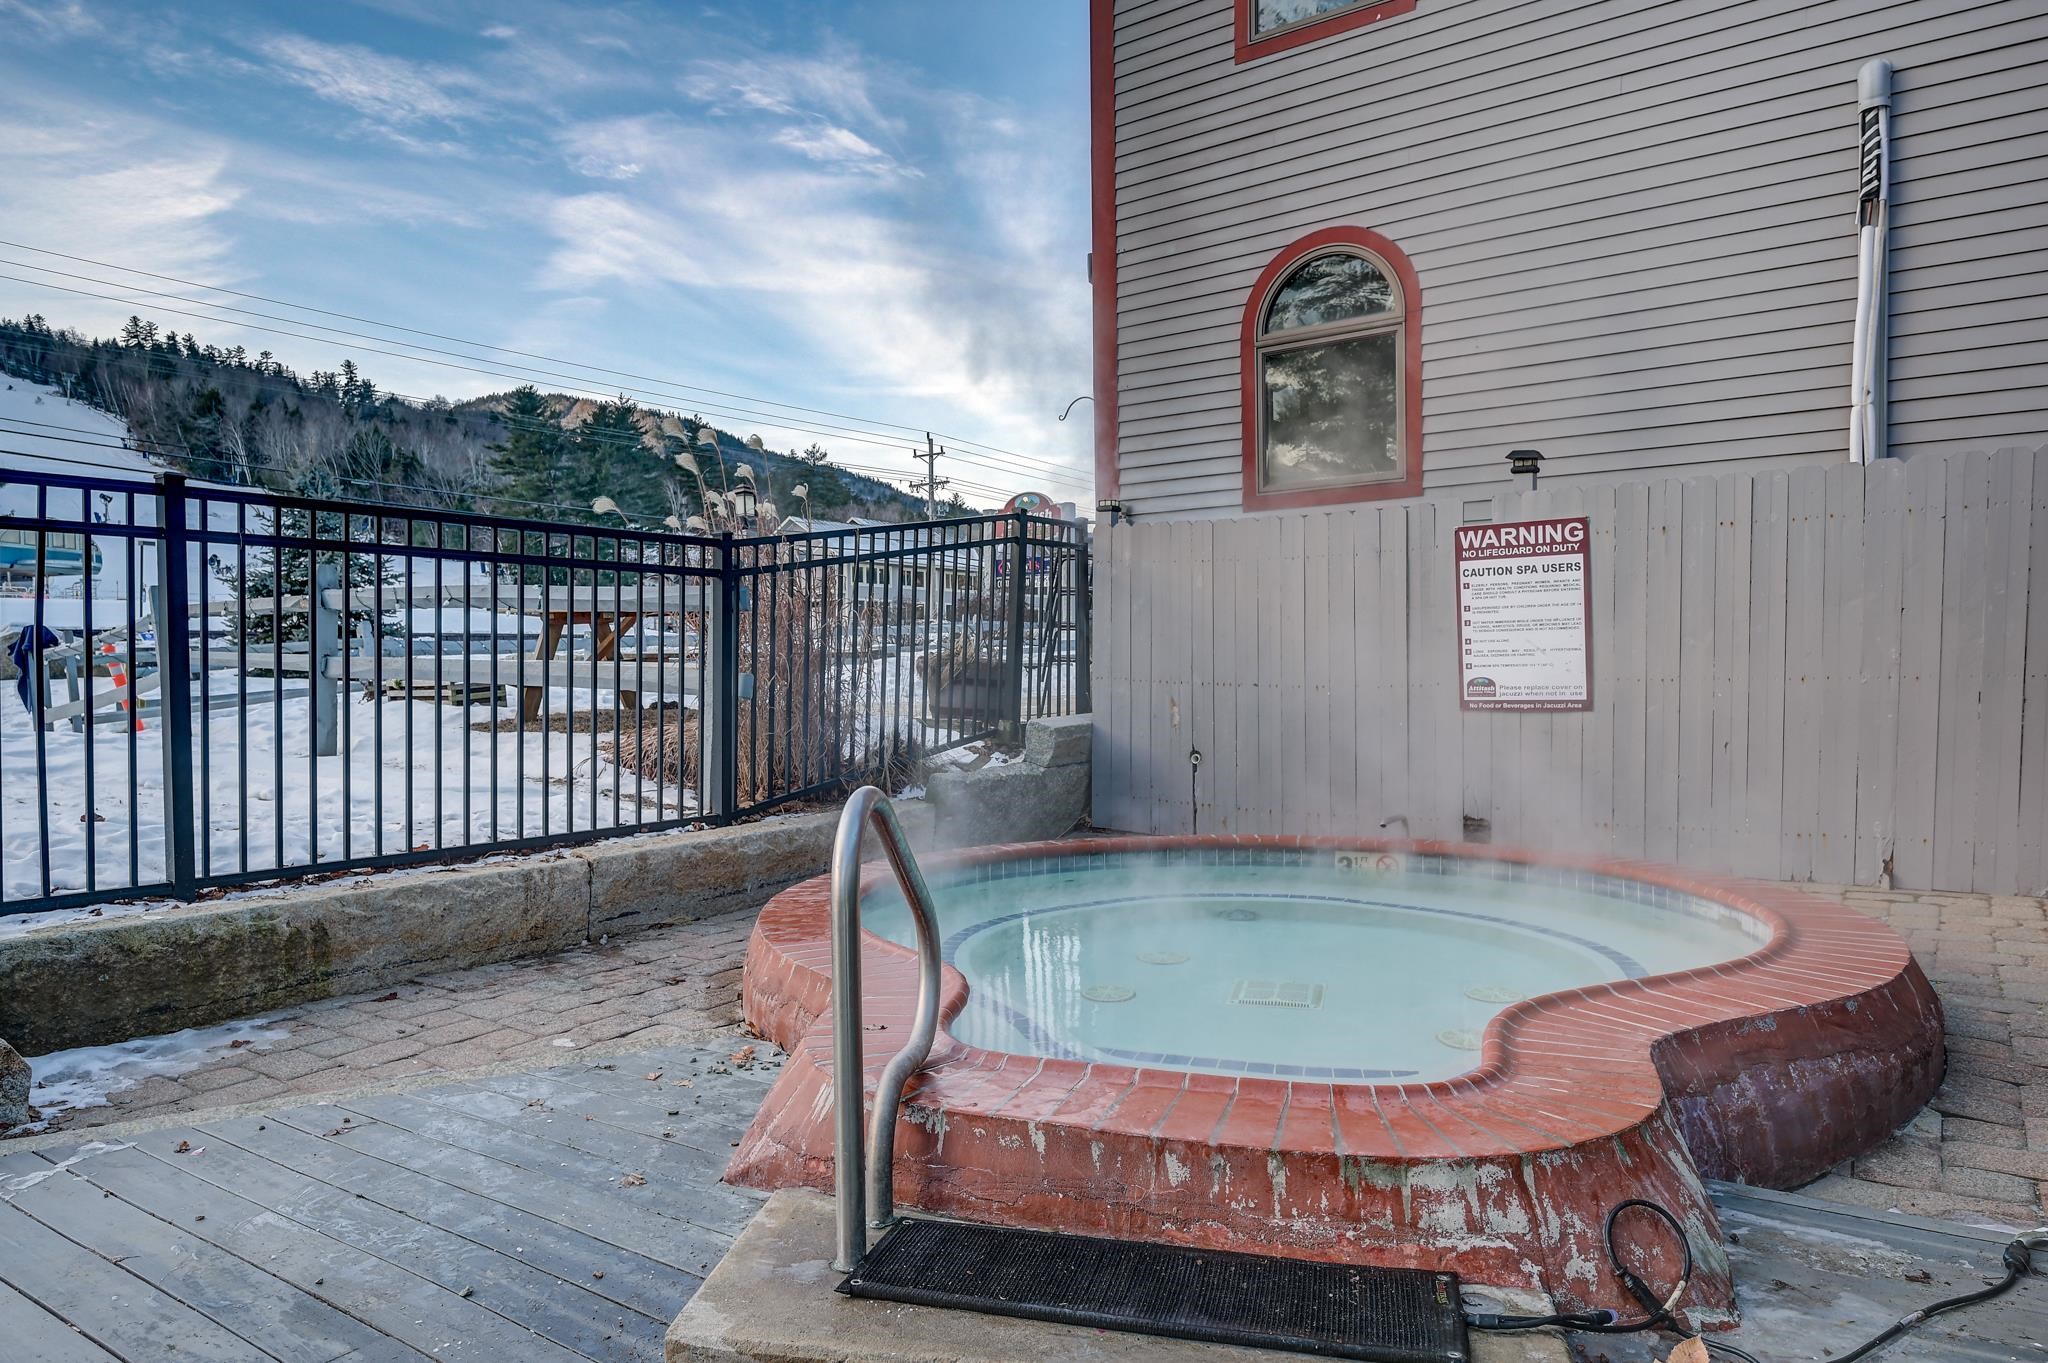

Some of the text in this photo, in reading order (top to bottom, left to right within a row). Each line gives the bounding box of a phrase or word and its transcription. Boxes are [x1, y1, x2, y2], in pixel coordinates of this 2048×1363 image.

[1459, 522, 1584, 549] WARNING
[1462, 543, 1580, 558] NO LIFEGUARD ON DUTY
[1463, 562, 1581, 578] CAUTION SPA USERS
